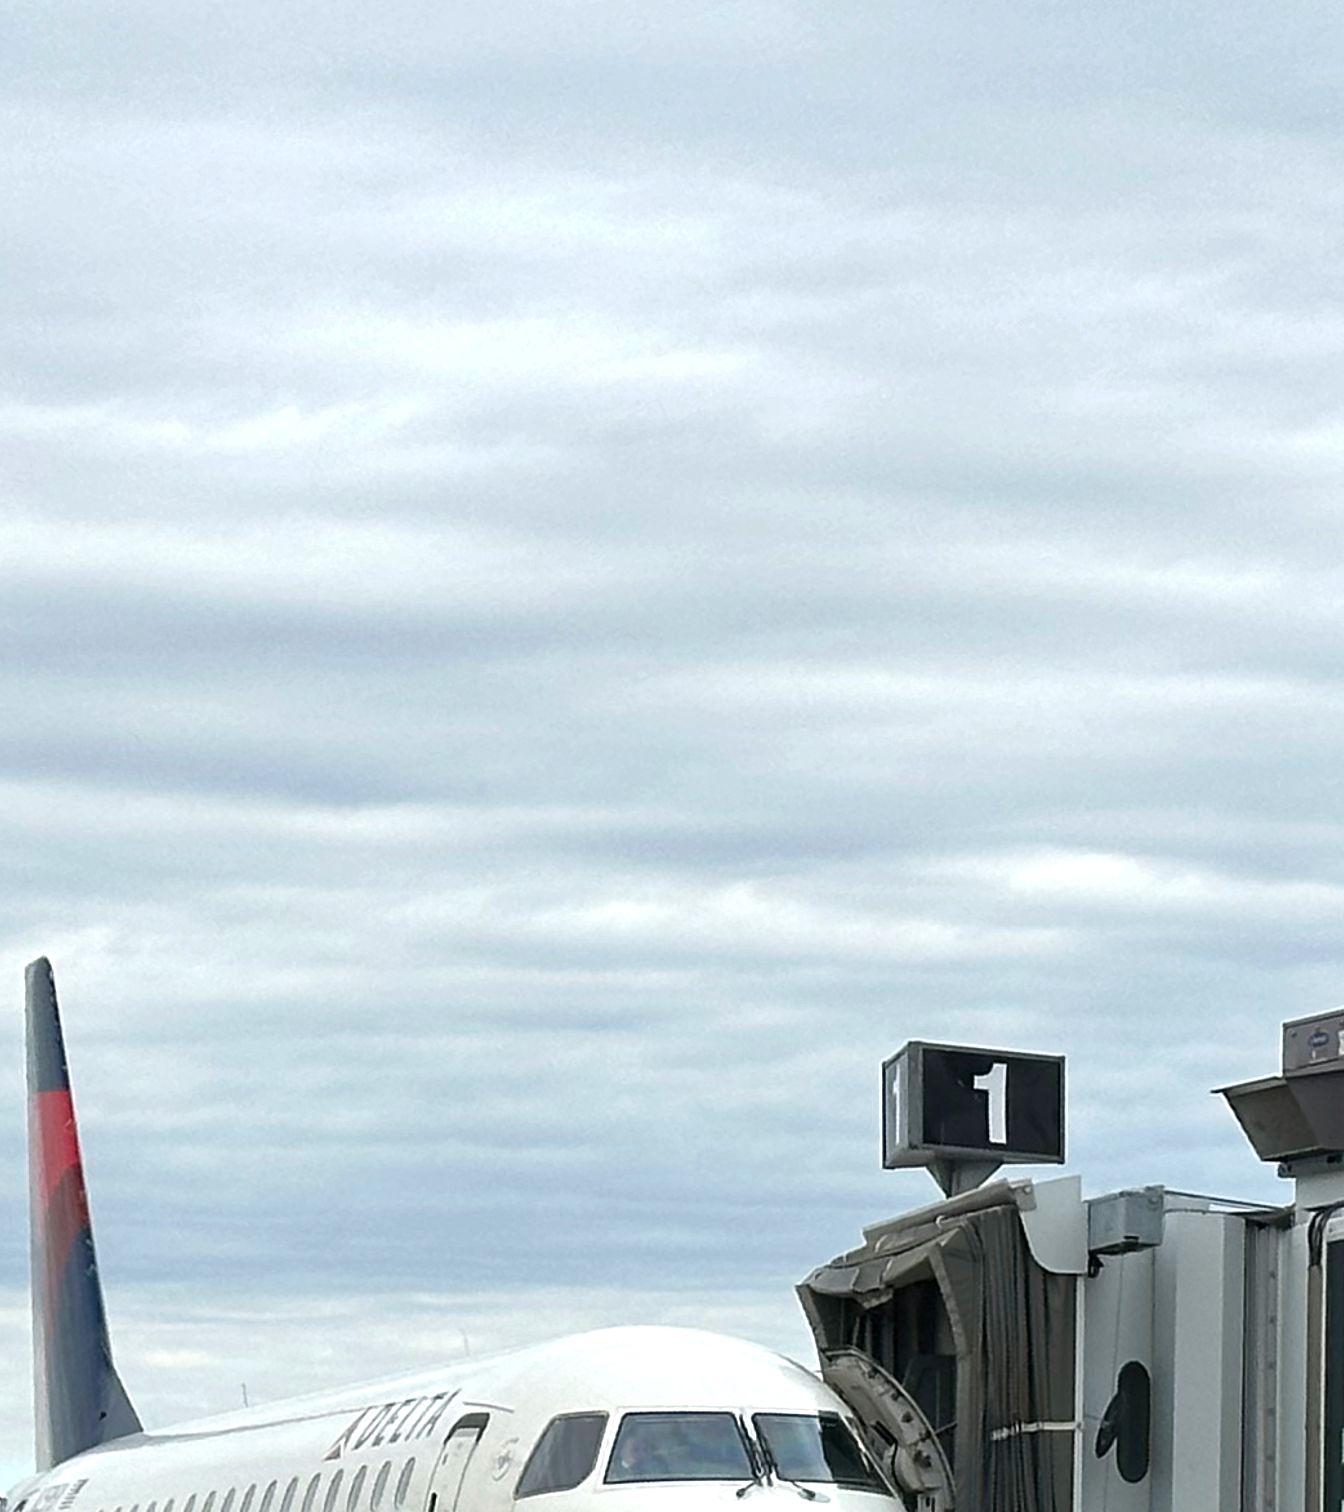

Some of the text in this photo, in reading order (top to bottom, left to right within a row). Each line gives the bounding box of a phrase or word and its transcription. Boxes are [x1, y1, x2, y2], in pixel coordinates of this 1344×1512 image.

[893, 1064, 900, 1146] 1
[973, 1062, 1007, 1144] 1
[352, 1389, 462, 1450] DELTA
